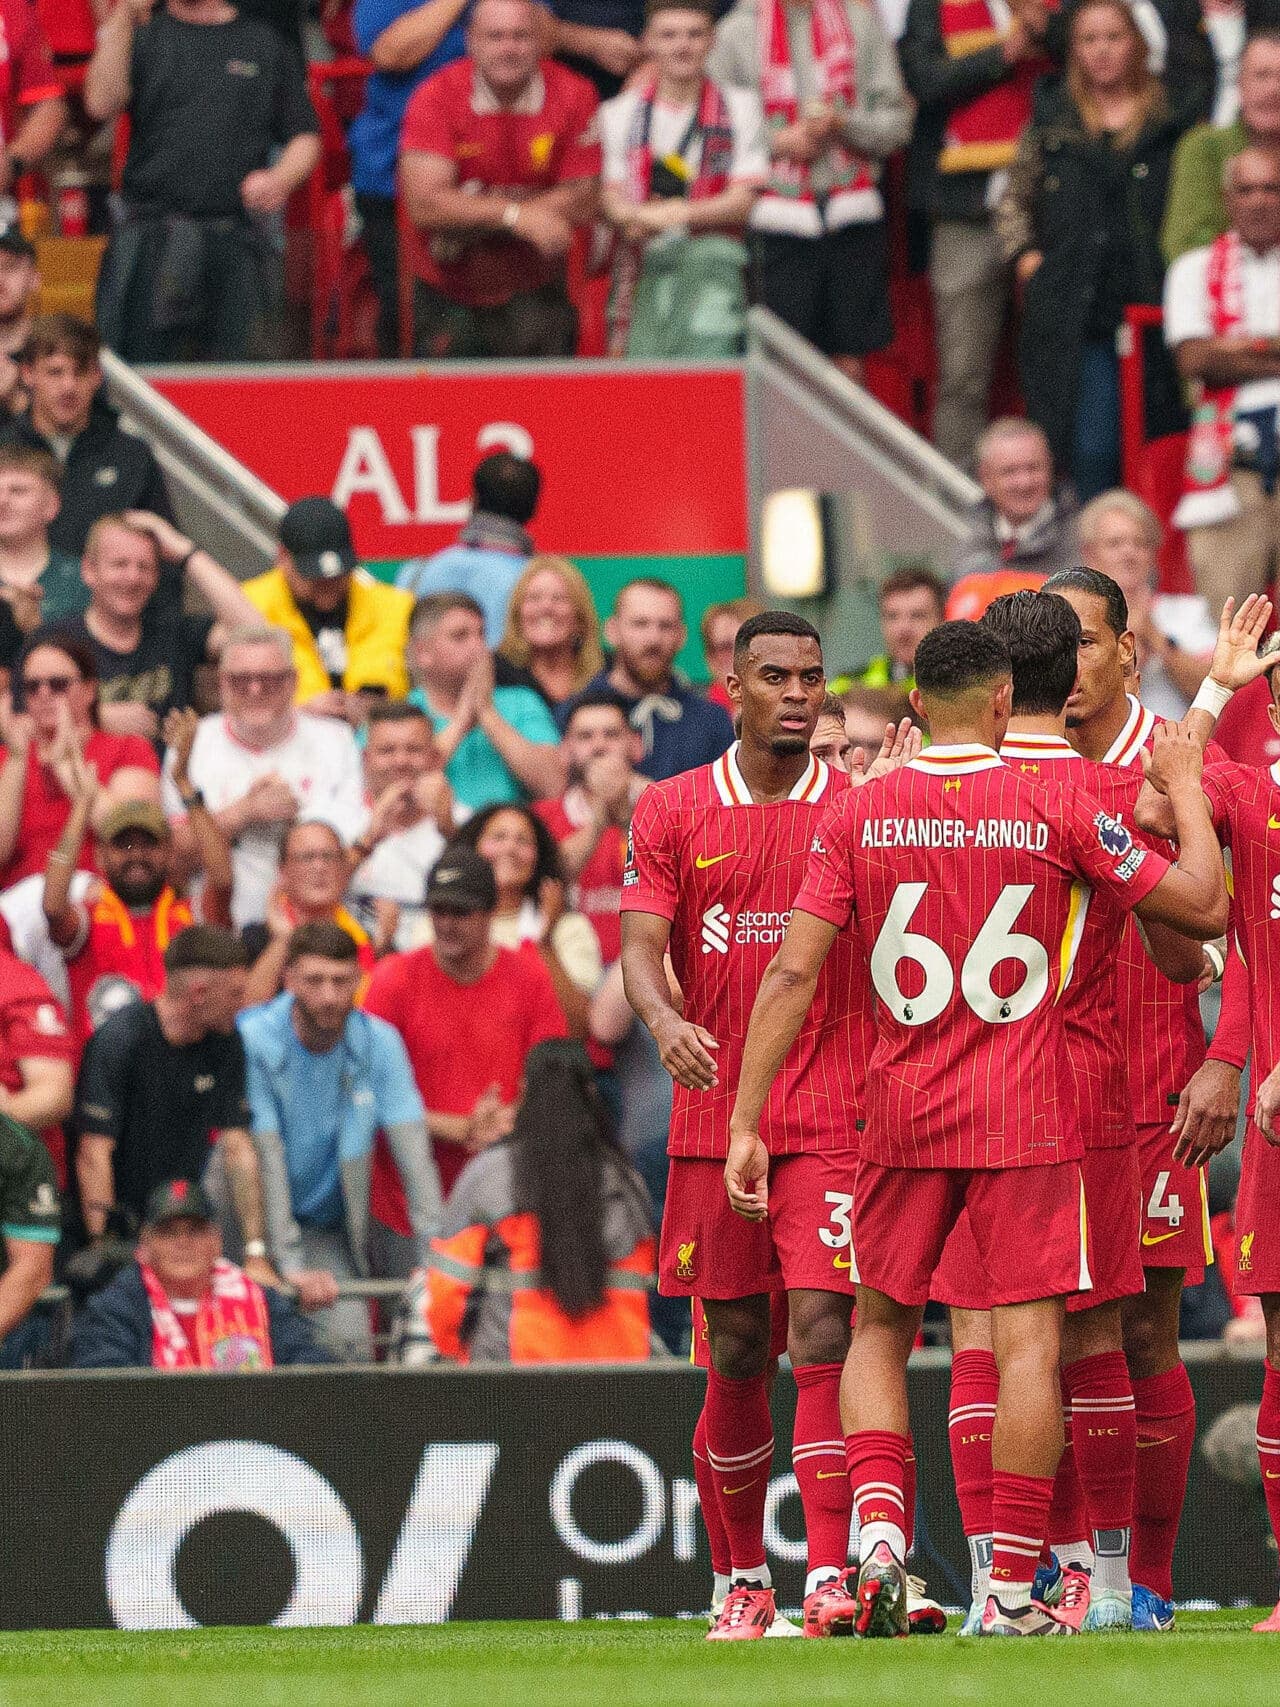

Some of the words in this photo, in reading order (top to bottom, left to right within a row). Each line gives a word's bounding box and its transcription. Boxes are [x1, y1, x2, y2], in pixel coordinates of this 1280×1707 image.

[861, 818, 1048, 850] ALEXANDER-ARNOLD
[735, 910, 793, 927] stand
[870, 882, 1049, 1026] 66
[1147, 1171, 1184, 1226] 4
[961, 1433, 991, 1444] LFC
[1088, 1428, 1119, 1436] LFC
[864, 1511, 889, 1522] LFC
